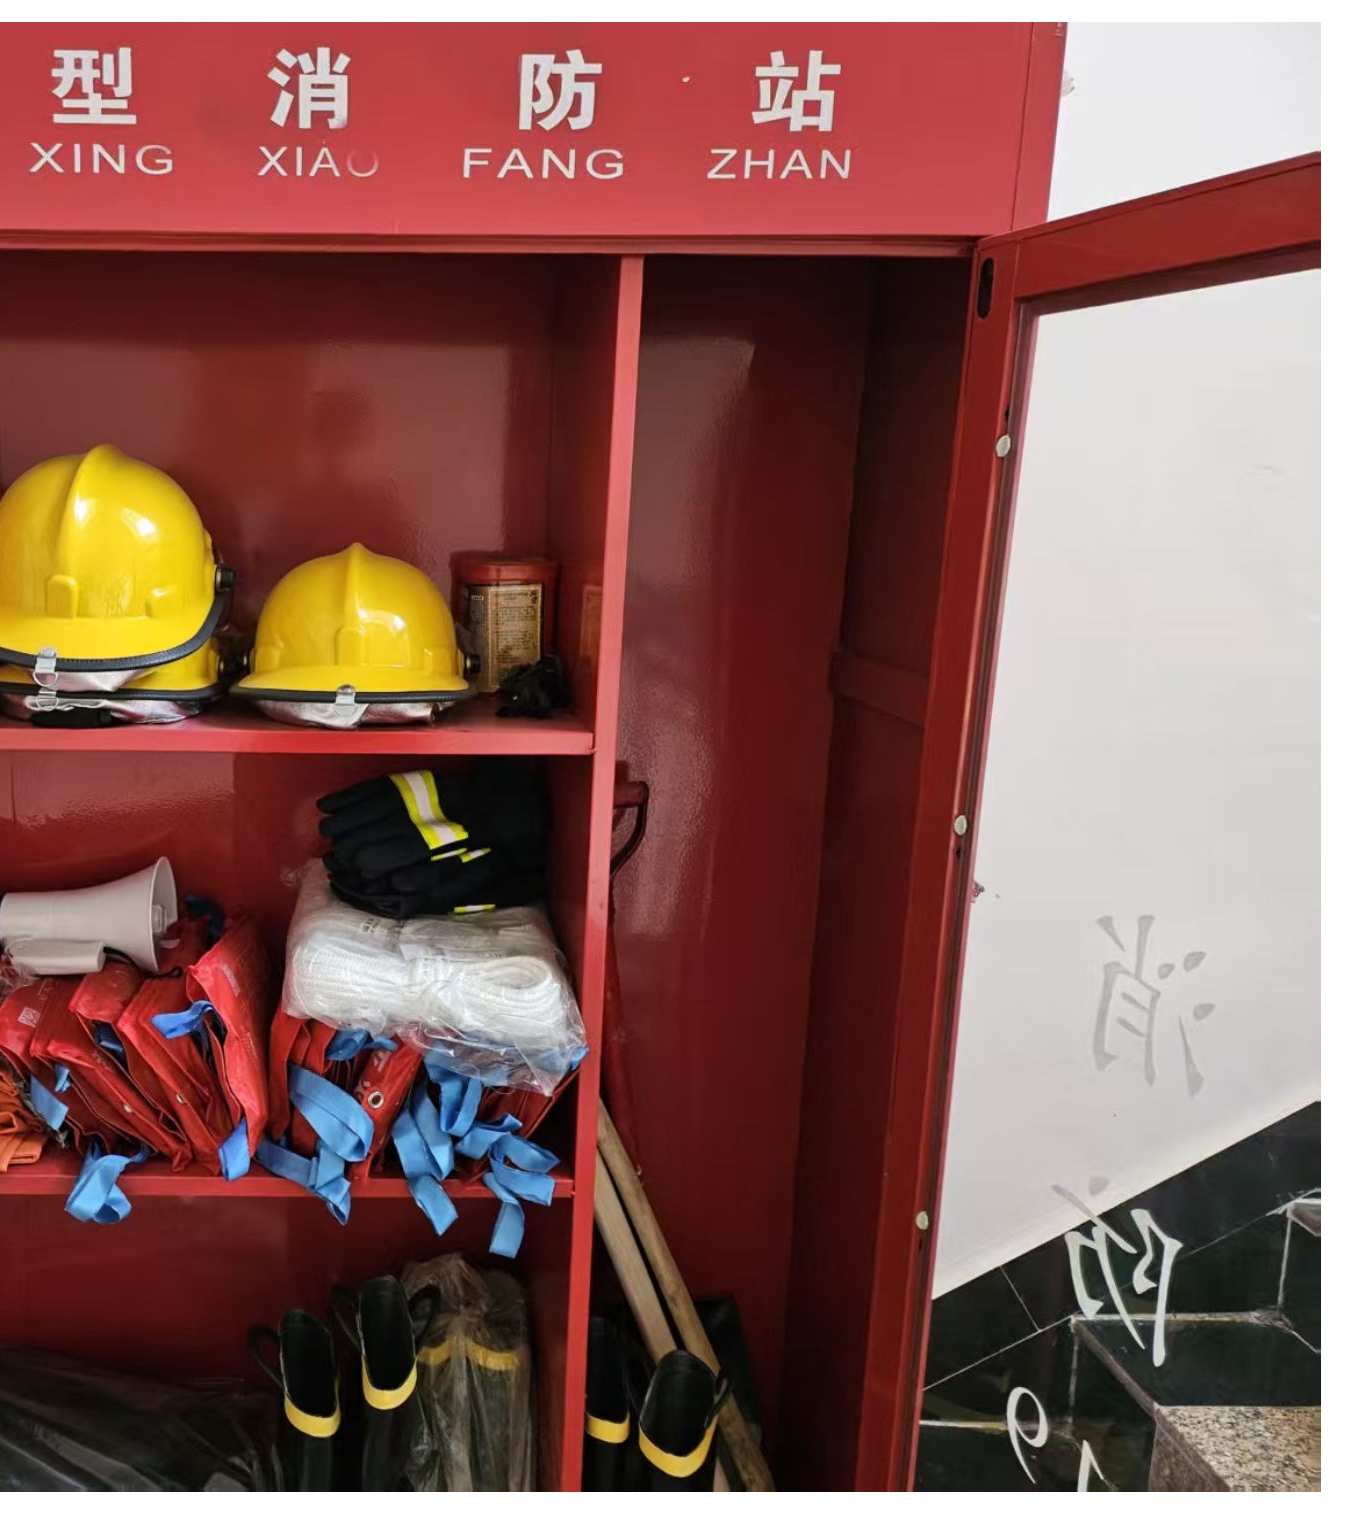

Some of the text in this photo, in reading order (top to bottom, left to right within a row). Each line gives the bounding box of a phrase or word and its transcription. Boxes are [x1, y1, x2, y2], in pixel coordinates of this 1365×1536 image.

[32, 143, 172, 174] XING
[464, 149, 623, 178] FANG
[708, 150, 850, 178] ZHAN
